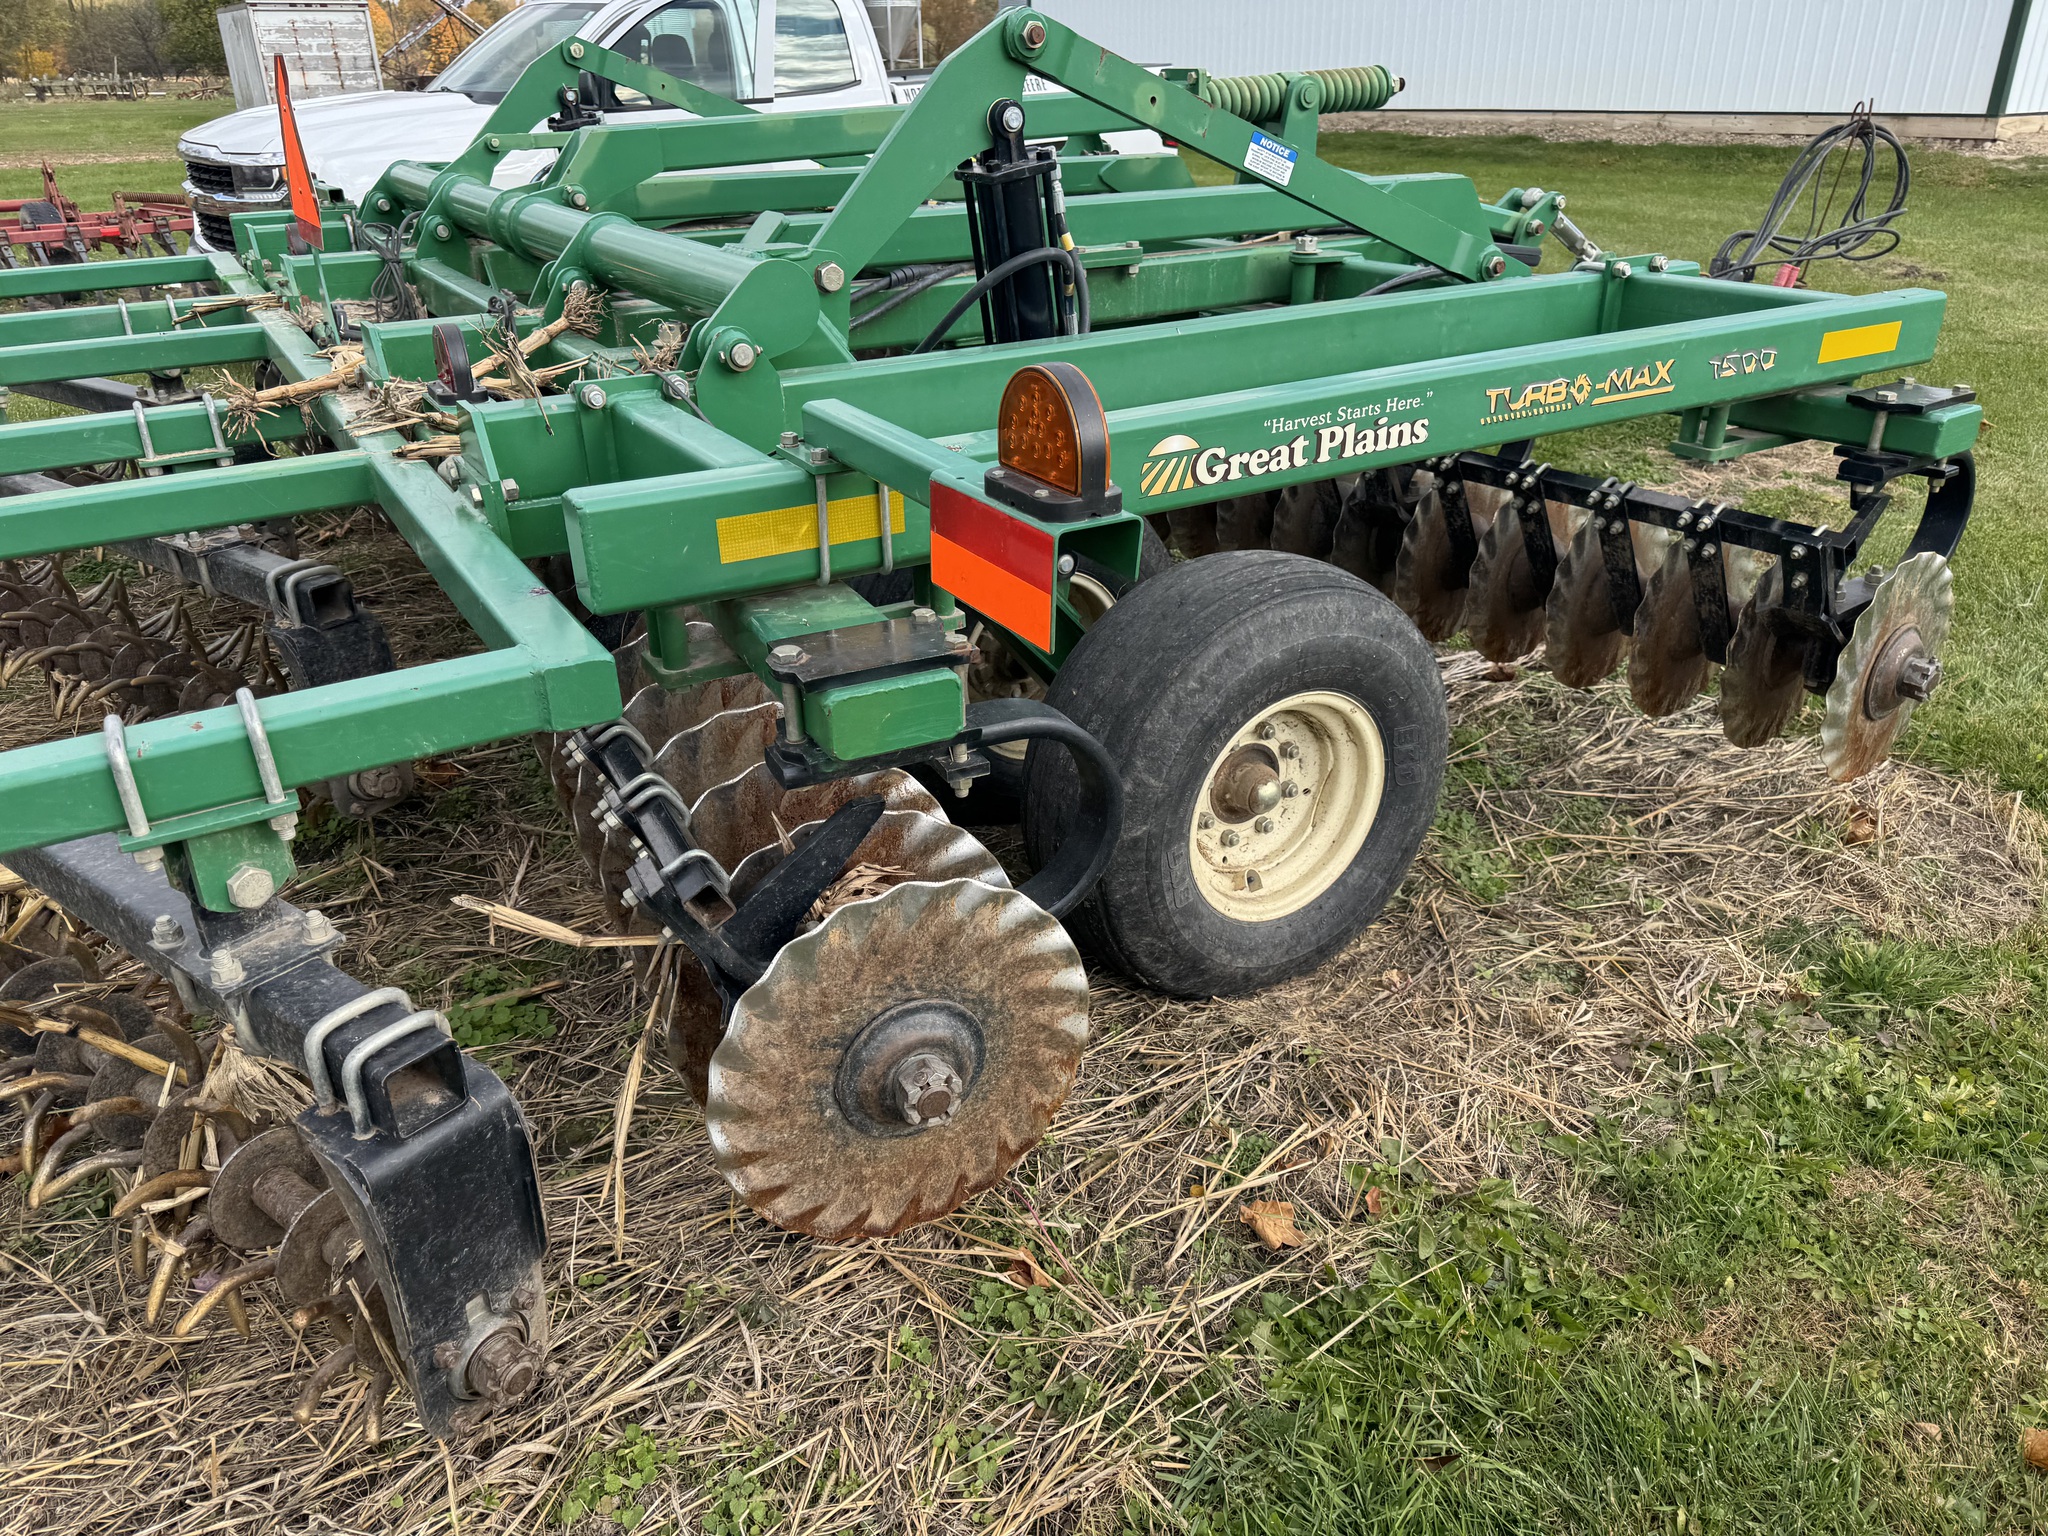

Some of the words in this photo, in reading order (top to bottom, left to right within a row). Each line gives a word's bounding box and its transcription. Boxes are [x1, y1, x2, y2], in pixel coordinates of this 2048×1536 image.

[1260, 137, 1291, 158] NOTICE
[1336, 404, 1381, 421] Starts
[1192, 434, 1310, 485] Great
[1315, 416, 1430, 464] Plains
